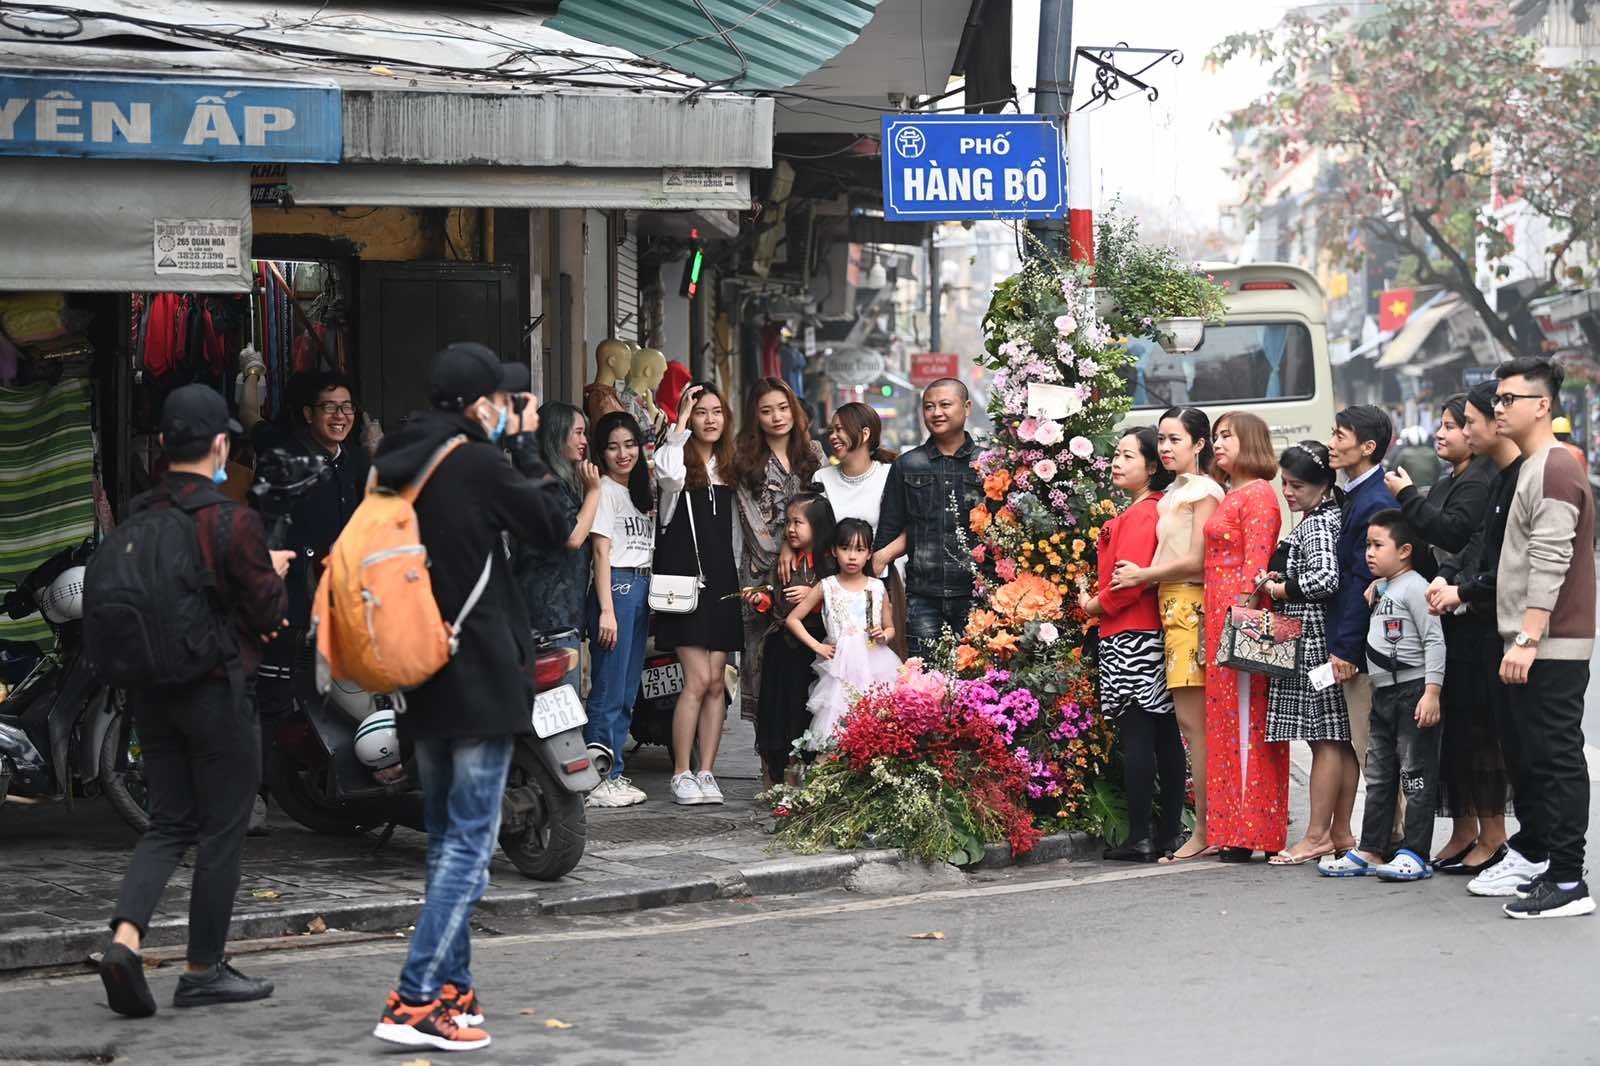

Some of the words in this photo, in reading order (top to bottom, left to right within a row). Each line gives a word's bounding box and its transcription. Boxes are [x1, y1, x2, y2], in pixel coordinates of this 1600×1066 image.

[182, 90, 297, 147] ẤP
[960, 131, 1012, 155] PHỐ
[903, 160, 993, 201] HÀNG
[1004, 157, 1048, 202] BỒ
[177, 238, 190, 246] 265
[646, 665, 679, 682] 29-C1
